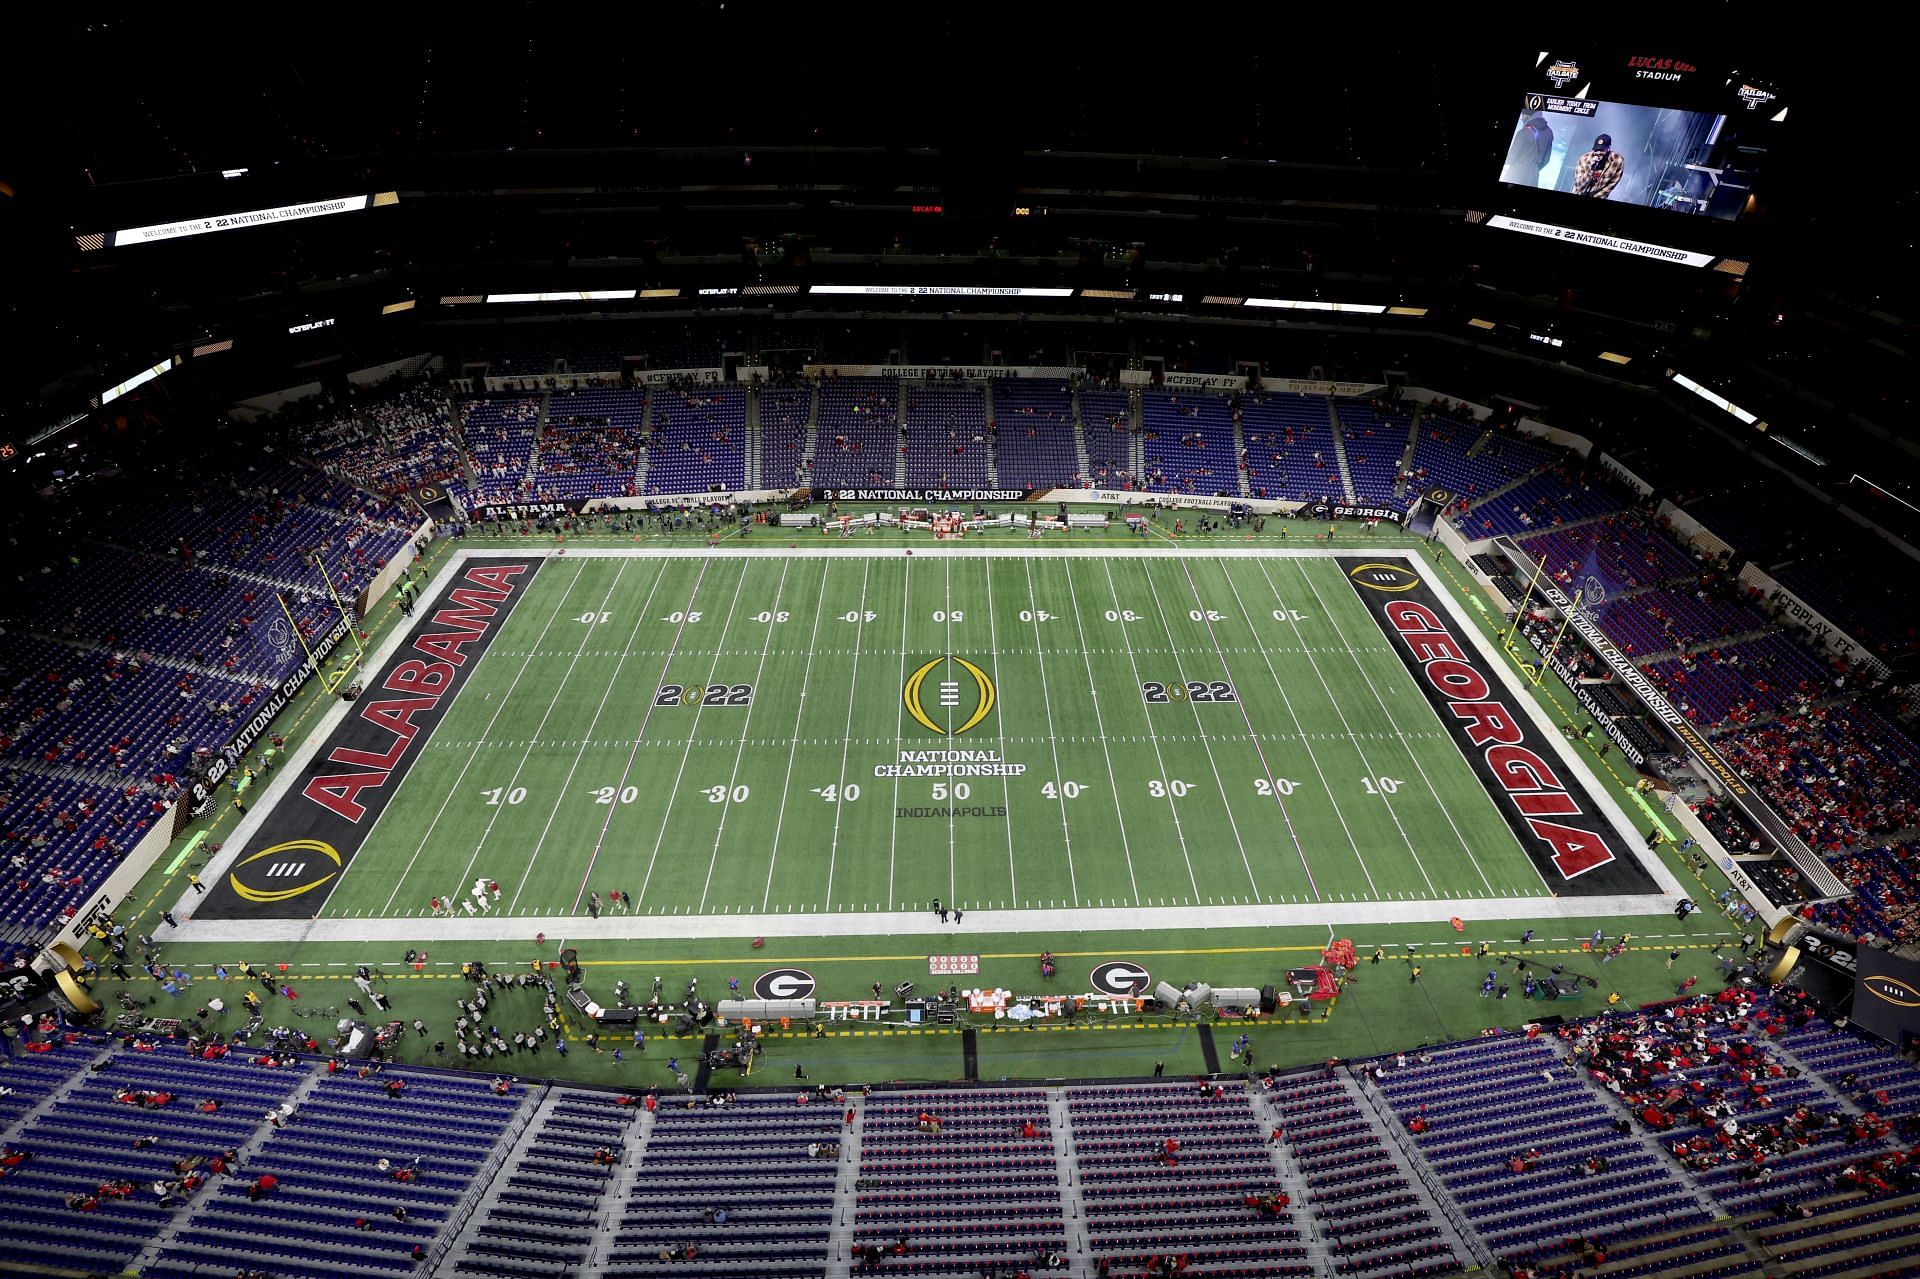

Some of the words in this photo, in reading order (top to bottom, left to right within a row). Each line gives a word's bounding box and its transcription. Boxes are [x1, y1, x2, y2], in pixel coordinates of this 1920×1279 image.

[1628, 56, 1673, 69] LUCAS
[1636, 71, 1681, 81] STADIUM
[143, 227, 177, 238] WELCOME
[188, 223, 203, 231] THE
[230, 212, 279, 225] NATIONAL
[279, 202, 346, 218] CHAMPIONSHIP
[1509, 221, 1534, 232] WELCOME
[1576, 233, 1619, 248] NATIONAL
[1619, 241, 1688, 261] CHAMPIONSHIP
[881, 368, 919, 377] COLLEGE
[1, 445, 14, 458] 25
[858, 489, 923, 500] NATIONAL
[925, 490, 1023, 501] CHAMPIONSHIP
[1334, 506, 1400, 521] GEORGIA
[1465, 558, 1479, 575] ESPN
[302, 564, 529, 824] ALABAMA
[1546, 588, 1565, 606] CFP
[1560, 603, 1604, 650] NATIONAL
[1603, 648, 1683, 726] CHAMPIONSHIP
[1677, 725, 1747, 796] INDIANAPOLIS
[1540, 646, 1579, 694] NATIONAL
[1577, 688, 1644, 767] CHAMPIONSHIP
[228, 697, 286, 759] NATIONAL
[1384, 600, 1616, 880] GEORGIA
[899, 750, 1002, 763] NATIONAL
[874, 763, 1027, 777] CHAMPIONSHIP
[594, 785, 640, 805] 20
[708, 784, 751, 804] 30
[819, 783, 861, 803] 40
[931, 782, 971, 801] 50
[1041, 781, 1080, 800] 40
[1148, 779, 1188, 798] 30
[1254, 778, 1295, 797] 20
[1360, 776, 1399, 796] 10
[485, 786, 528, 806] 10
[896, 806, 1008, 818] INDIANAPOLIS
[1731, 870, 1753, 892] AT&T
[72, 894, 111, 939] ESPN
